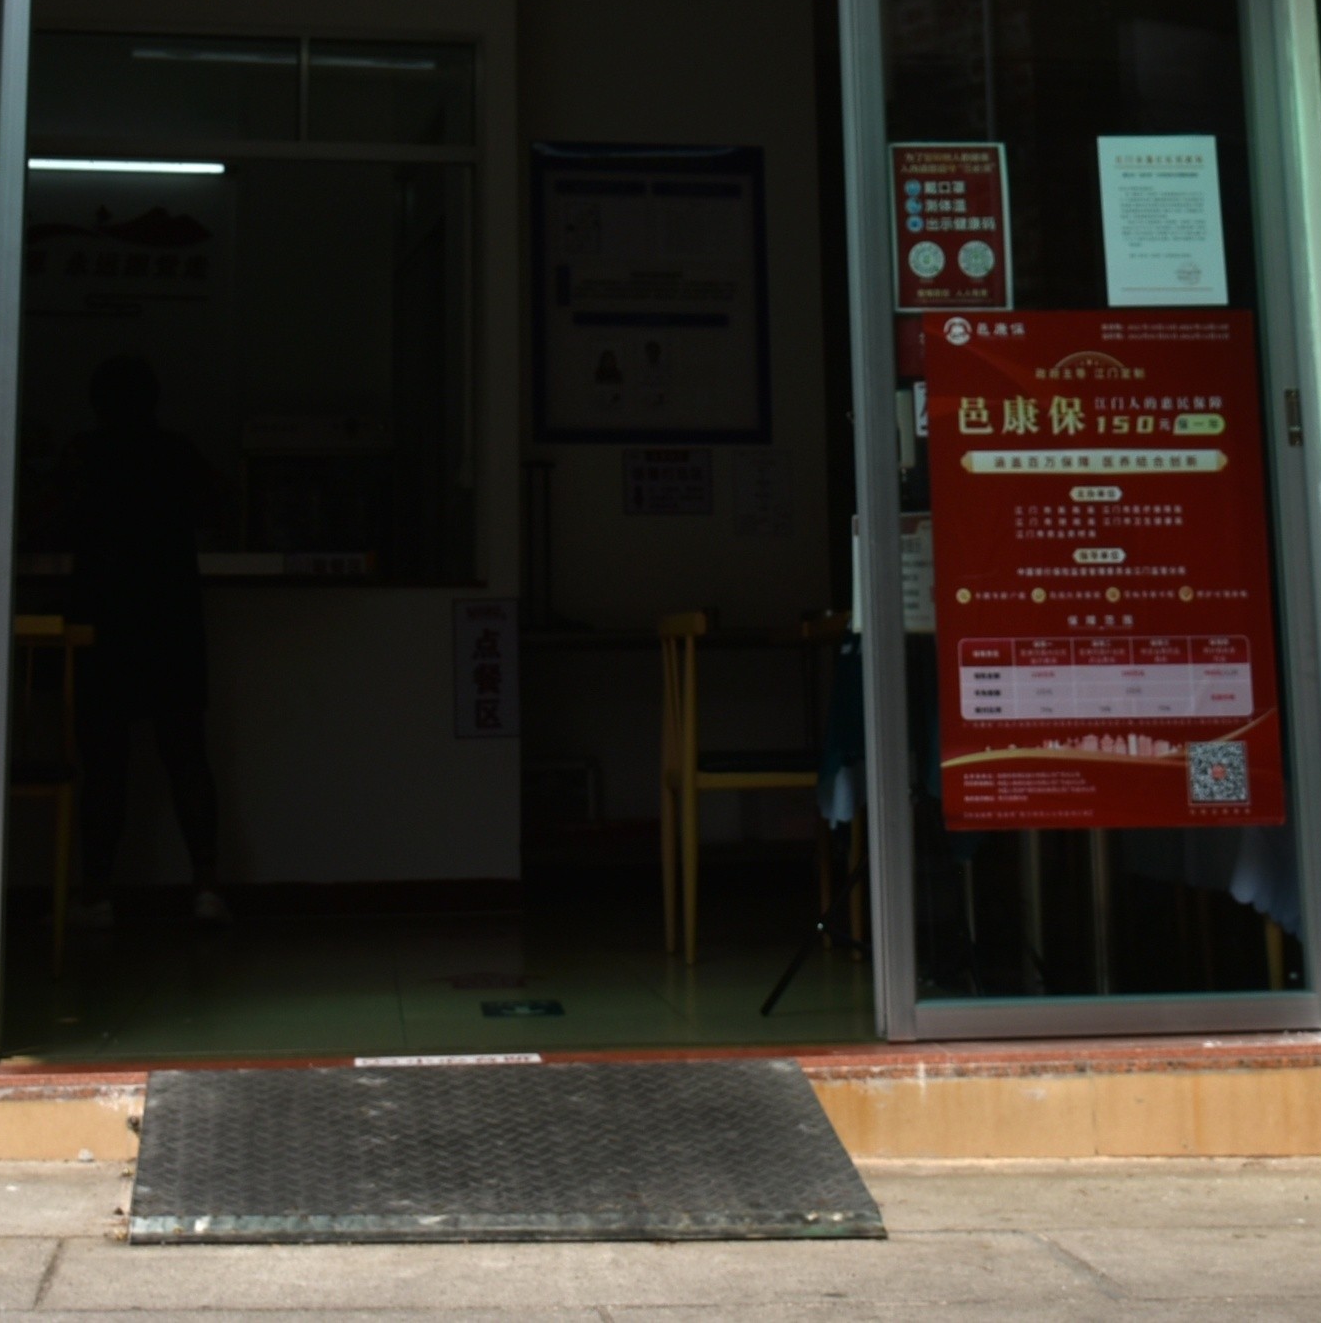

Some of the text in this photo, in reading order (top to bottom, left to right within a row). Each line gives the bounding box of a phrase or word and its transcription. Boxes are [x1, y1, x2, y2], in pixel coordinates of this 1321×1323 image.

[957, 395, 1086, 436] 邑康保
[1094, 396, 1224, 411] 江门人的惠民保障
